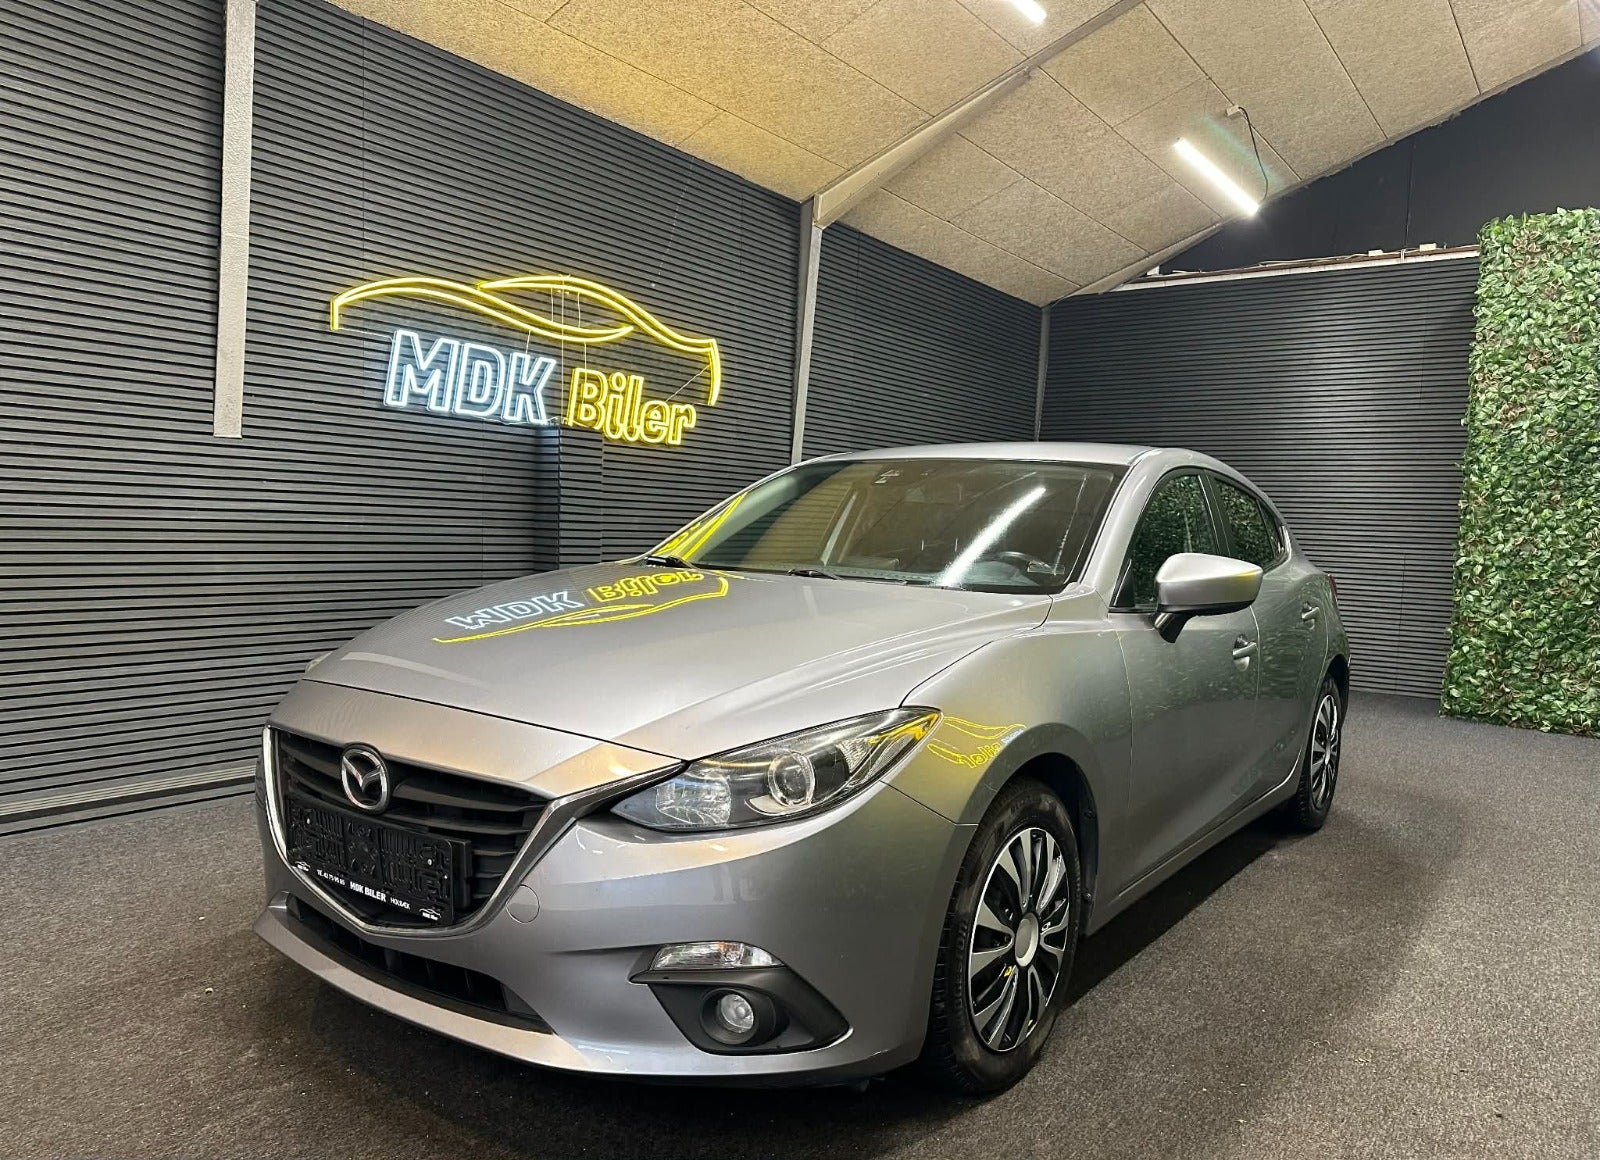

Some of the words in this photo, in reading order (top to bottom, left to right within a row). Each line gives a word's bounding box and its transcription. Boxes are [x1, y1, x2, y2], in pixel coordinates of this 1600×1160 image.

[383, 330, 557, 426] MDK
[566, 367, 697, 446] Biler
[364, 886, 387, 903] BILER
